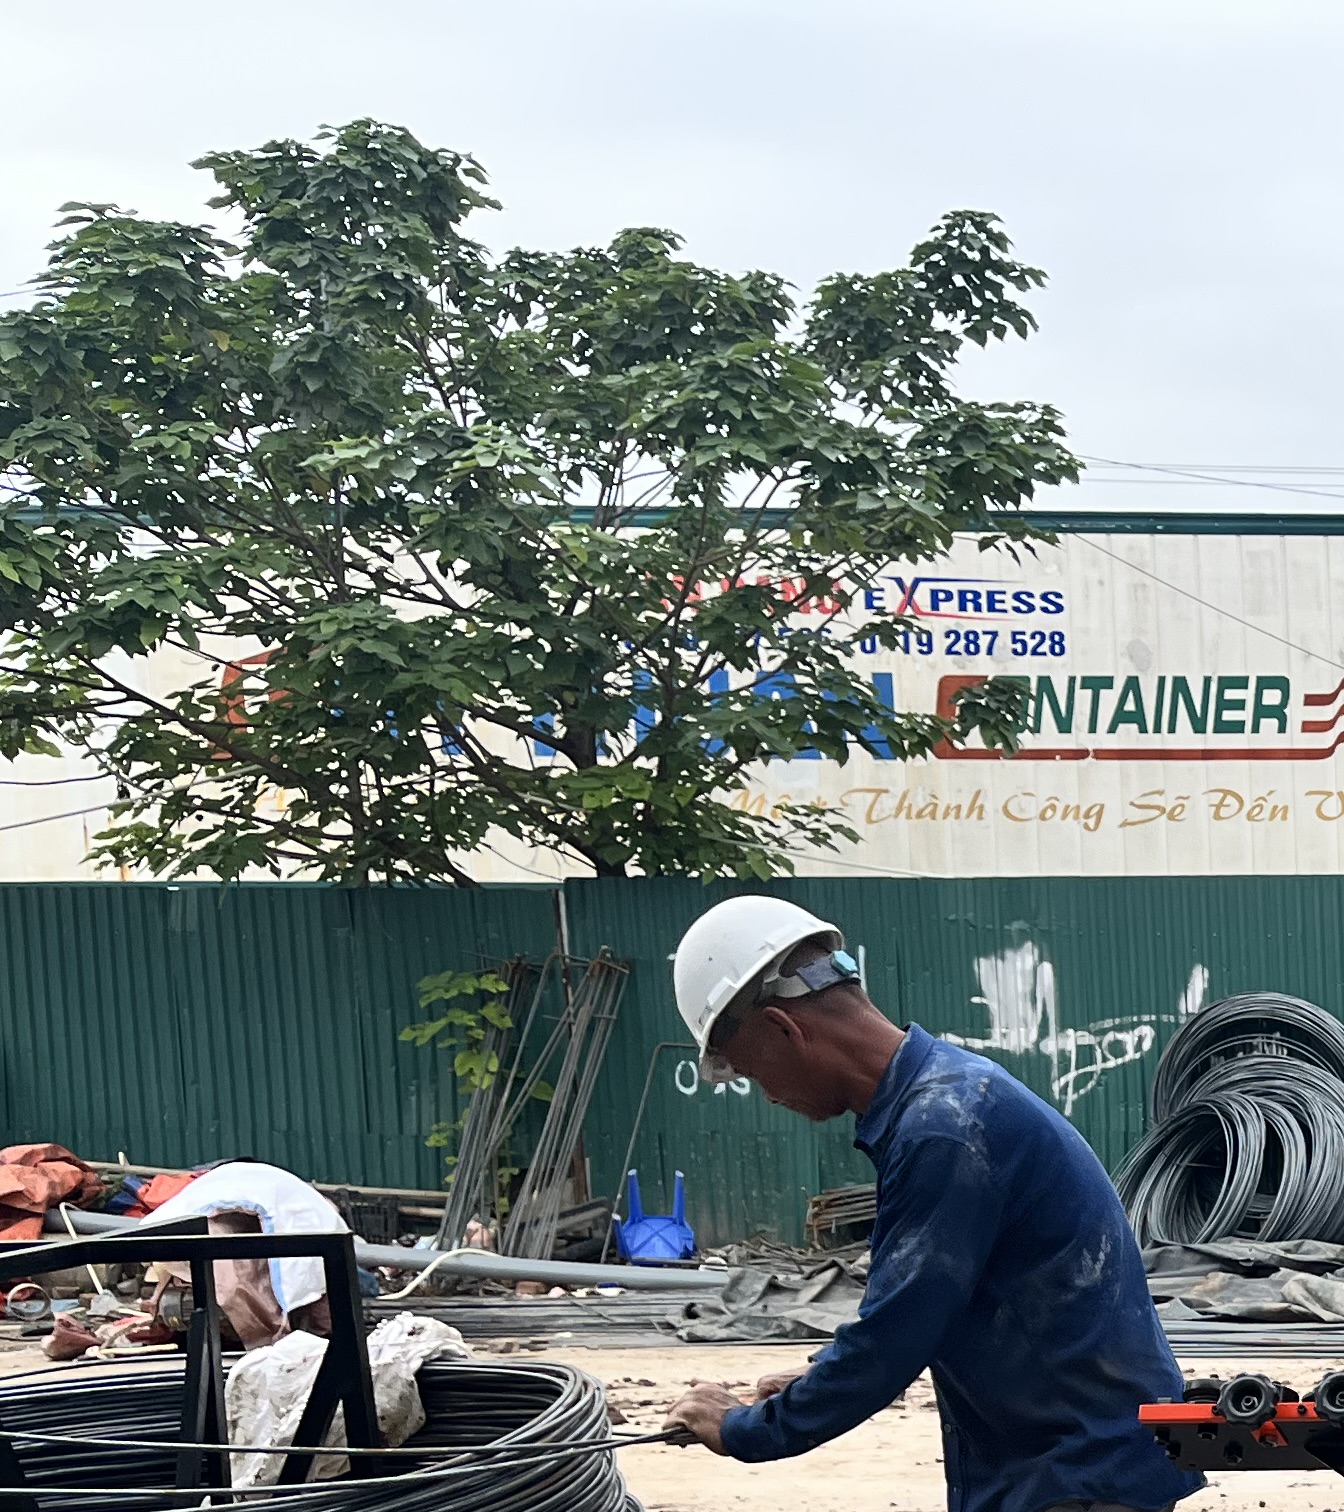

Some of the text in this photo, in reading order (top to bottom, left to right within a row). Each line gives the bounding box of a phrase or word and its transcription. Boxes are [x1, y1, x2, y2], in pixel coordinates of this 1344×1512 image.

[863, 577, 1065, 617] EXPRESS
[859, 629, 934, 655] 019
[944, 629, 999, 656] 287
[1010, 630, 1066, 656] 528
[839, 788, 985, 825] Thành
[1002, 792, 1105, 832] Công
[1118, 788, 1191, 828] Sẽ
[1201, 788, 1290, 822] Đến
